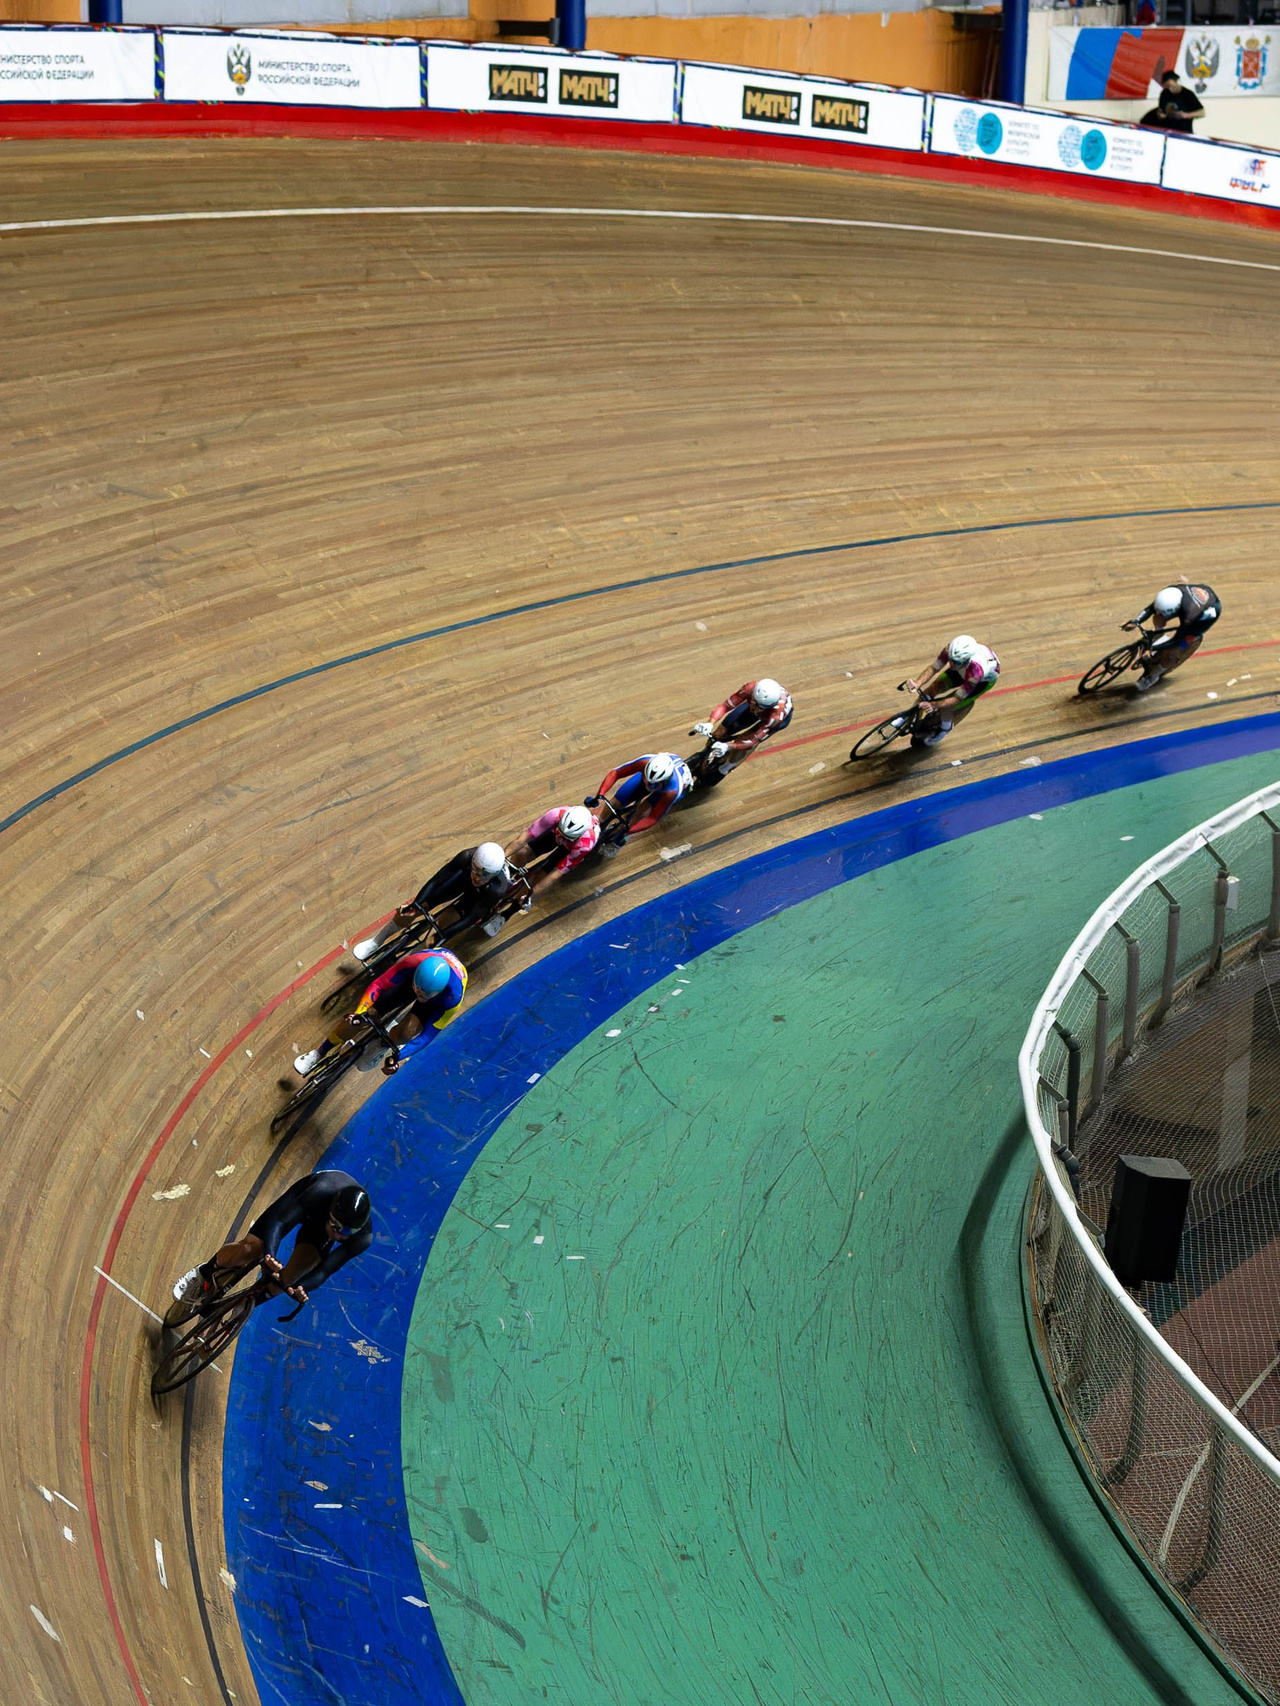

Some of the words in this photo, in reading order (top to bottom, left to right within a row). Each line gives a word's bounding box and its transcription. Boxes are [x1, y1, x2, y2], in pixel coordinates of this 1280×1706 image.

[54, 54, 85, 64] СПОРТА
[258, 60, 320, 71] МИНИСТЕРСТВО
[321, 63, 352, 72] СПОРТА
[46, 70, 94, 80] ФЕДЕРАЦИИ
[258, 74, 311, 85] РОССИЙСКОЙ
[313, 77, 361, 87] ФЕДЕРАЦИИ
[492, 69, 545, 98] МАТЧ!
[562, 74, 616, 103] МАТЧ!
[745, 90, 798, 120] МАТЧ!
[814, 99, 866, 129] МАТЧ!
